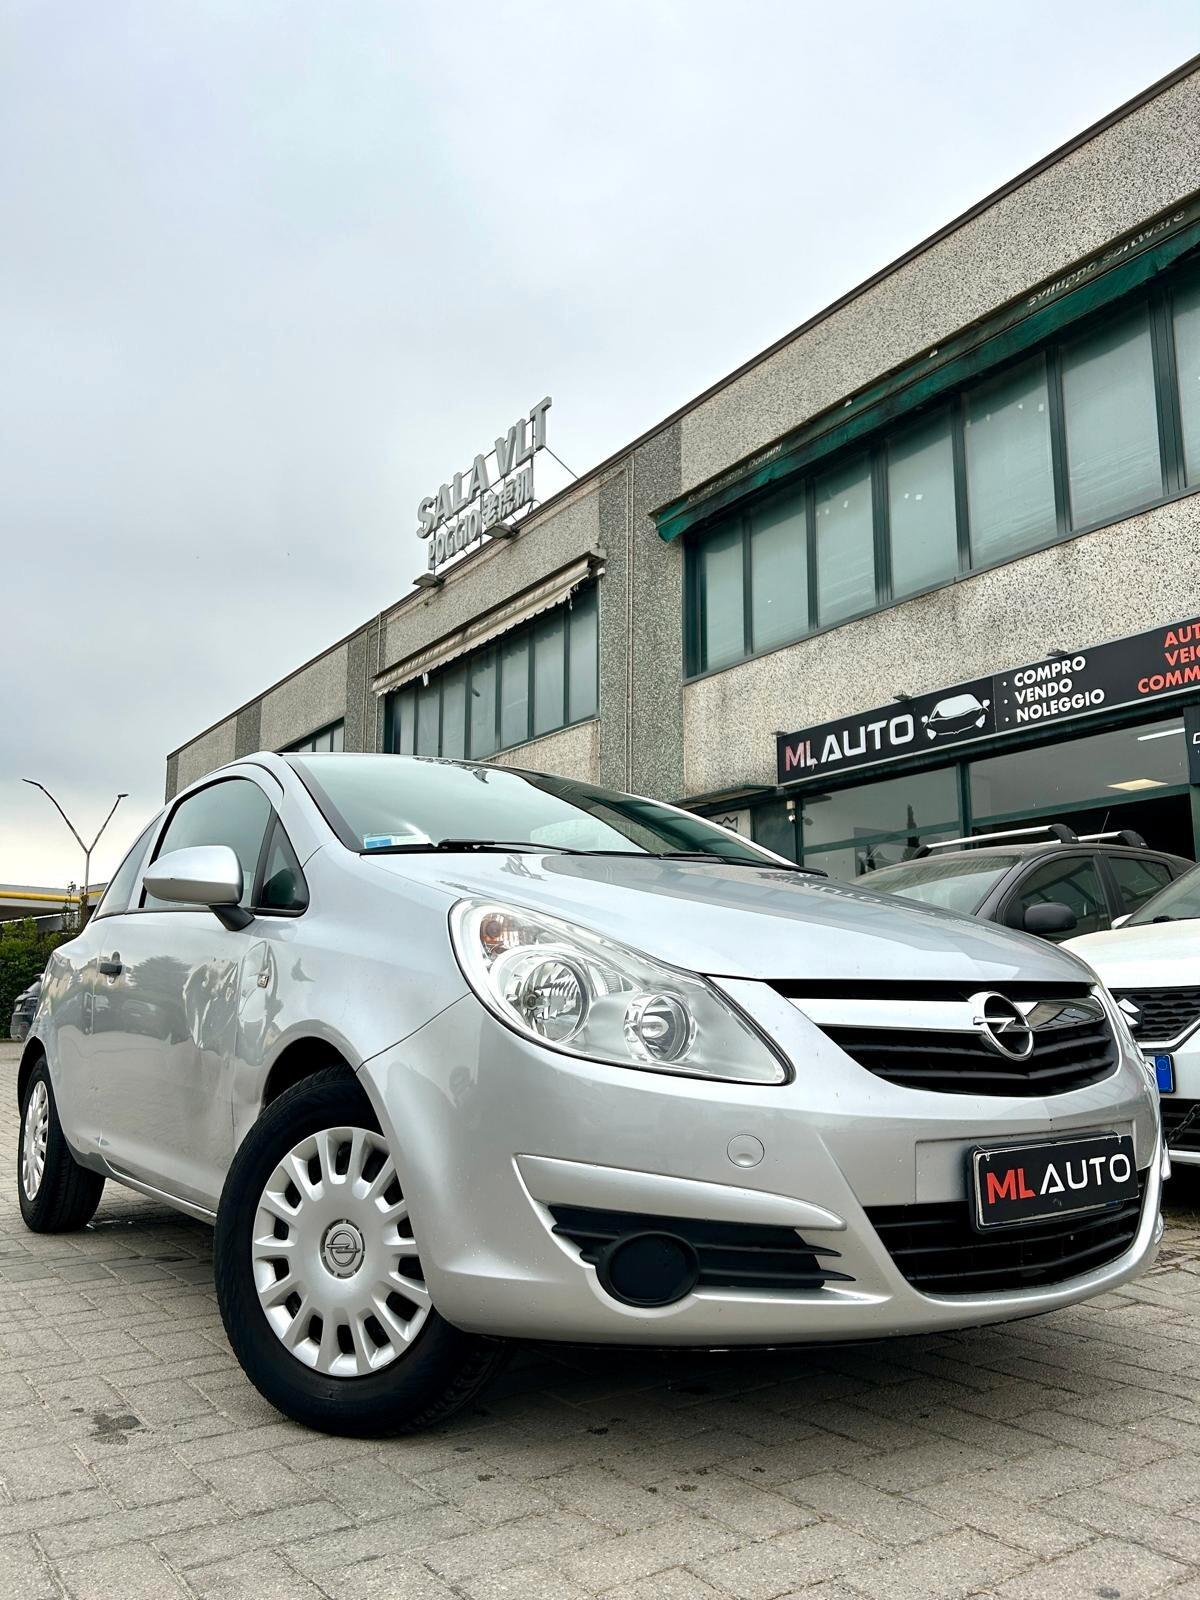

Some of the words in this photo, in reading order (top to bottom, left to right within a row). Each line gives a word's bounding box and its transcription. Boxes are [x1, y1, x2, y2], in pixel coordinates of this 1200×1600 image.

[416, 453, 490, 539] SALA
[494, 396, 552, 479] VLT
[428, 509, 483, 570] POGGIO
[1013, 655, 1086, 688] COMPRO
[1164, 645, 1200, 666] VEI
[1014, 678, 1073, 704] VENDO
[1015, 688, 1105, 723] NOLEGGIO
[986, 1168, 1036, 1205] ML
[1040, 1153, 1131, 1195] AUTO
